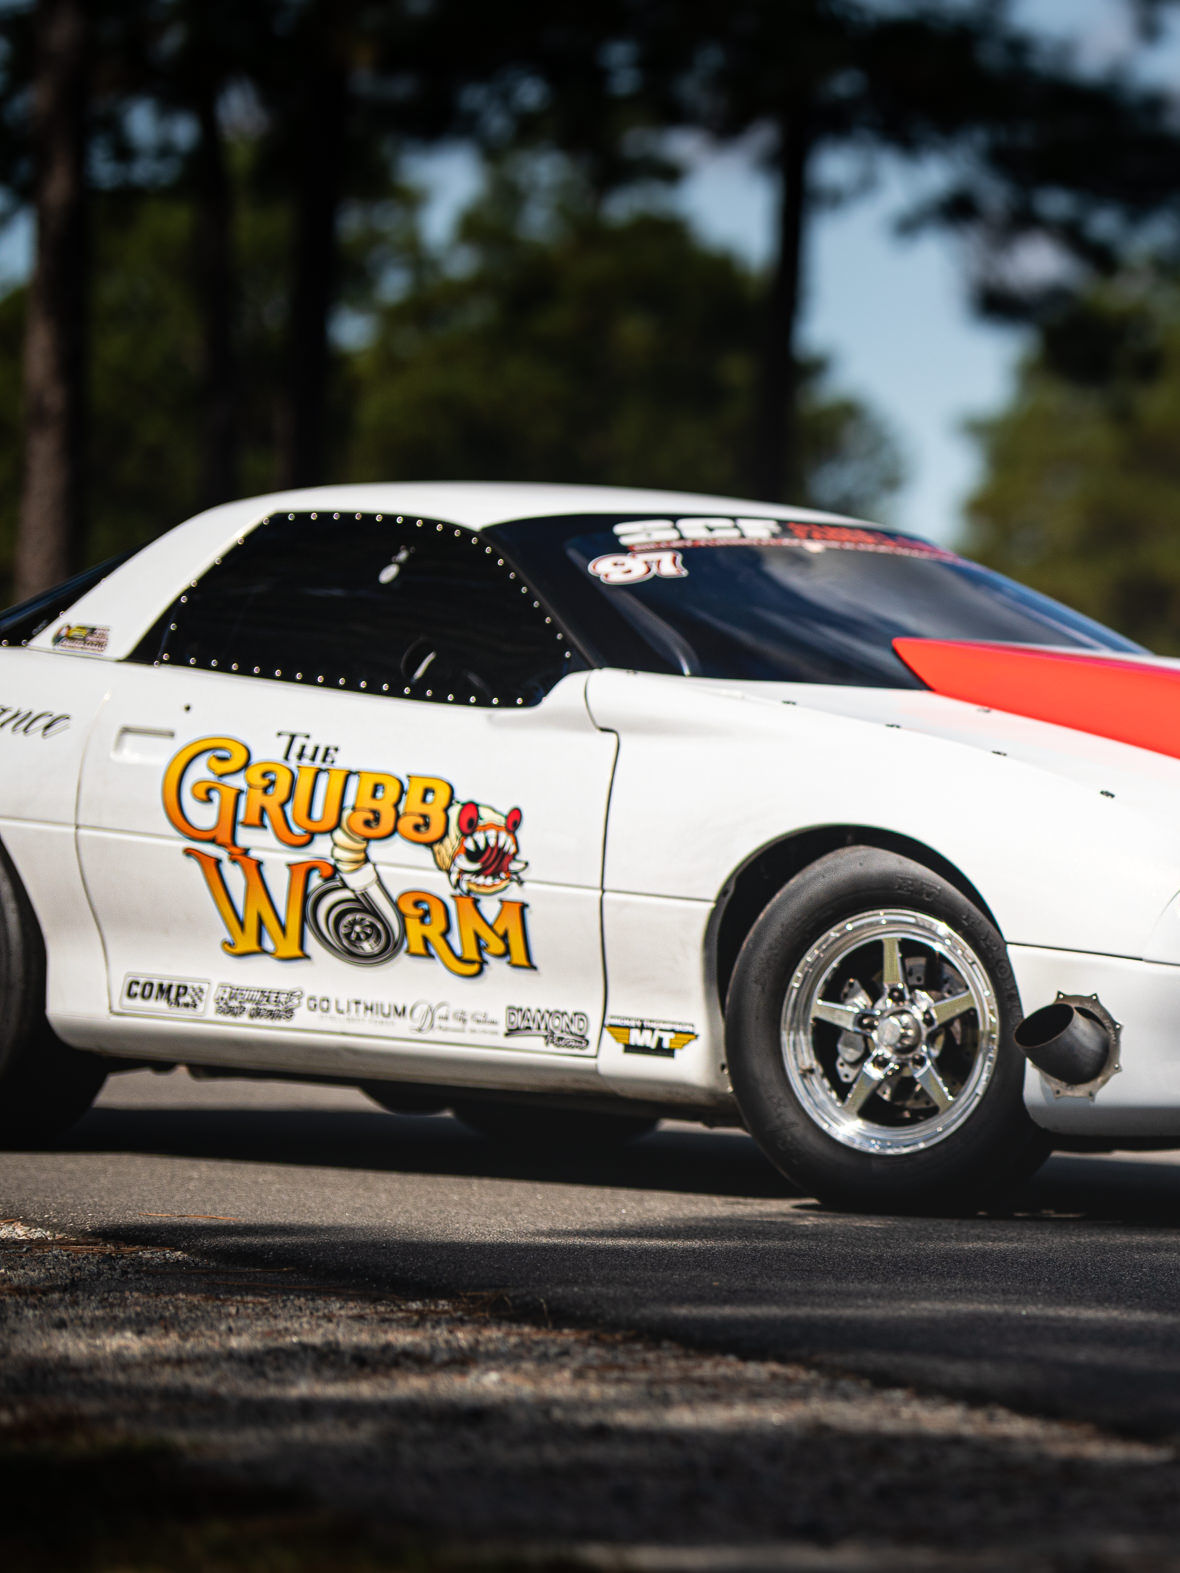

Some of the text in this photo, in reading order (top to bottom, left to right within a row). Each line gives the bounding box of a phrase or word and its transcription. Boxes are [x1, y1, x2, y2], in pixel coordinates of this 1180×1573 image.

[162, 735, 453, 852] GRUBB
[126, 980, 188, 1001] COMP
[506, 1005, 588, 1036] DIAMOND
[629, 1028, 676, 1050] M/T
